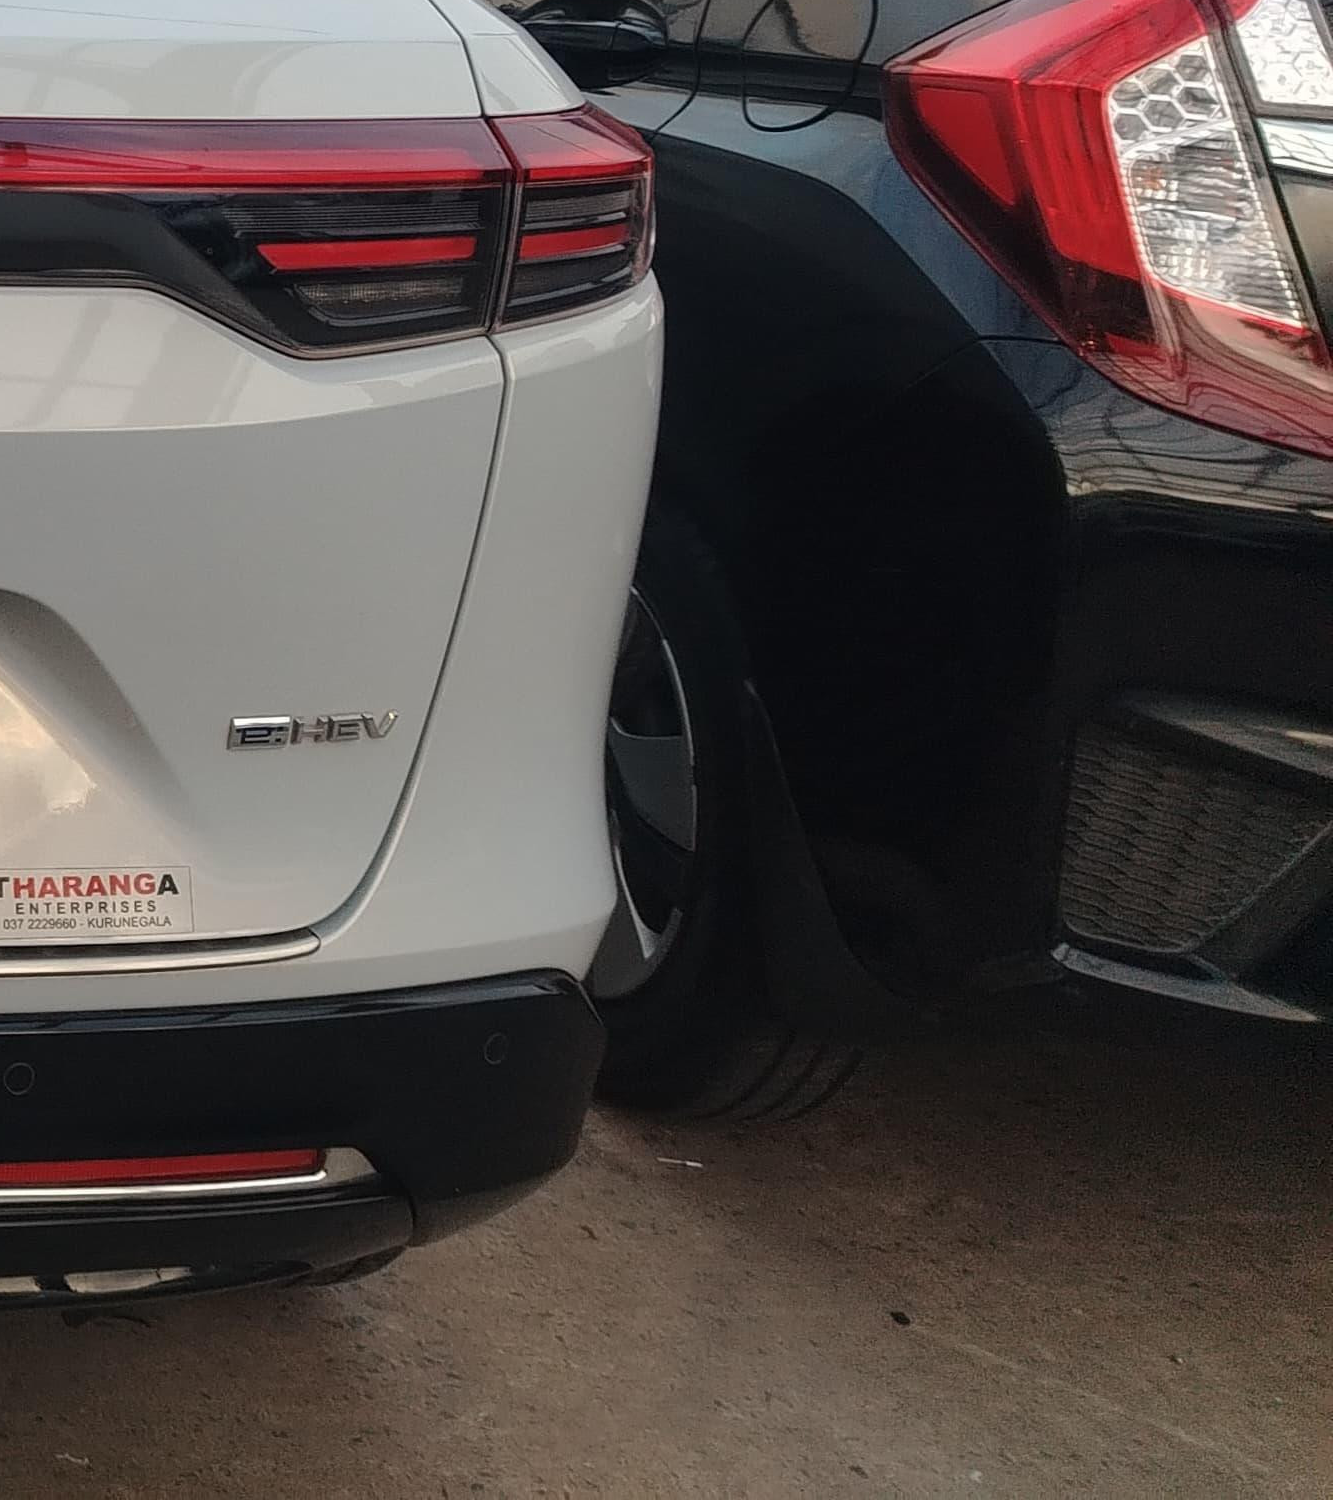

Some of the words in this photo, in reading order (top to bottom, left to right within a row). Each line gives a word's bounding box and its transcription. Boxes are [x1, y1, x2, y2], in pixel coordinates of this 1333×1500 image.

[14, 900, 158, 916] ENTERPRISES
[2, 917, 24, 930] 037
[26, 916, 77, 930] 2229660
[86, 915, 172, 929] KURUNEGALA
